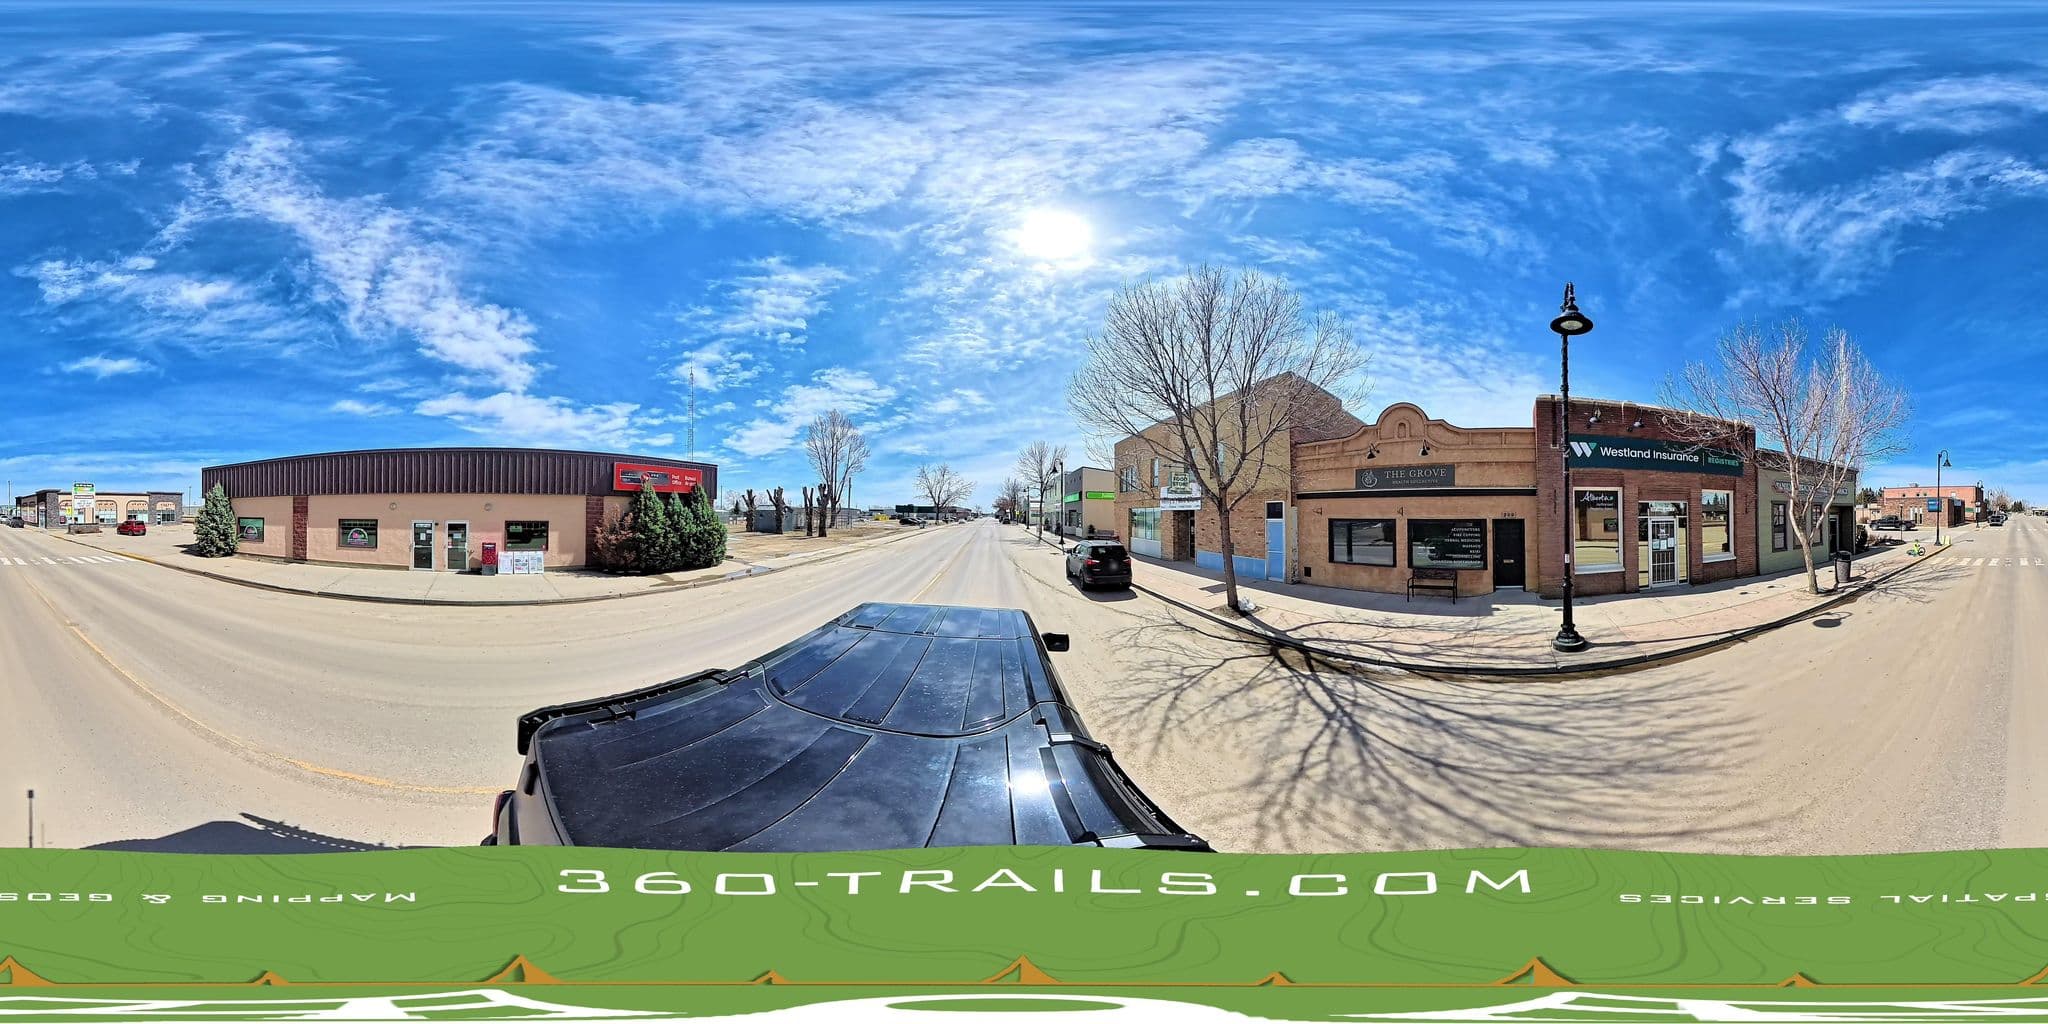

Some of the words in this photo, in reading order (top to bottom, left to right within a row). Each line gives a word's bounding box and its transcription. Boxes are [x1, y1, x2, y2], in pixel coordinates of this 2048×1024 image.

[1600, 446, 1651, 459] Westland
[1652, 451, 1700, 463] Insurance
[1384, 470, 1406, 479] THE
[1409, 468, 1447, 478] GROVE
[1580, 490, 1609, 502] Alberta
